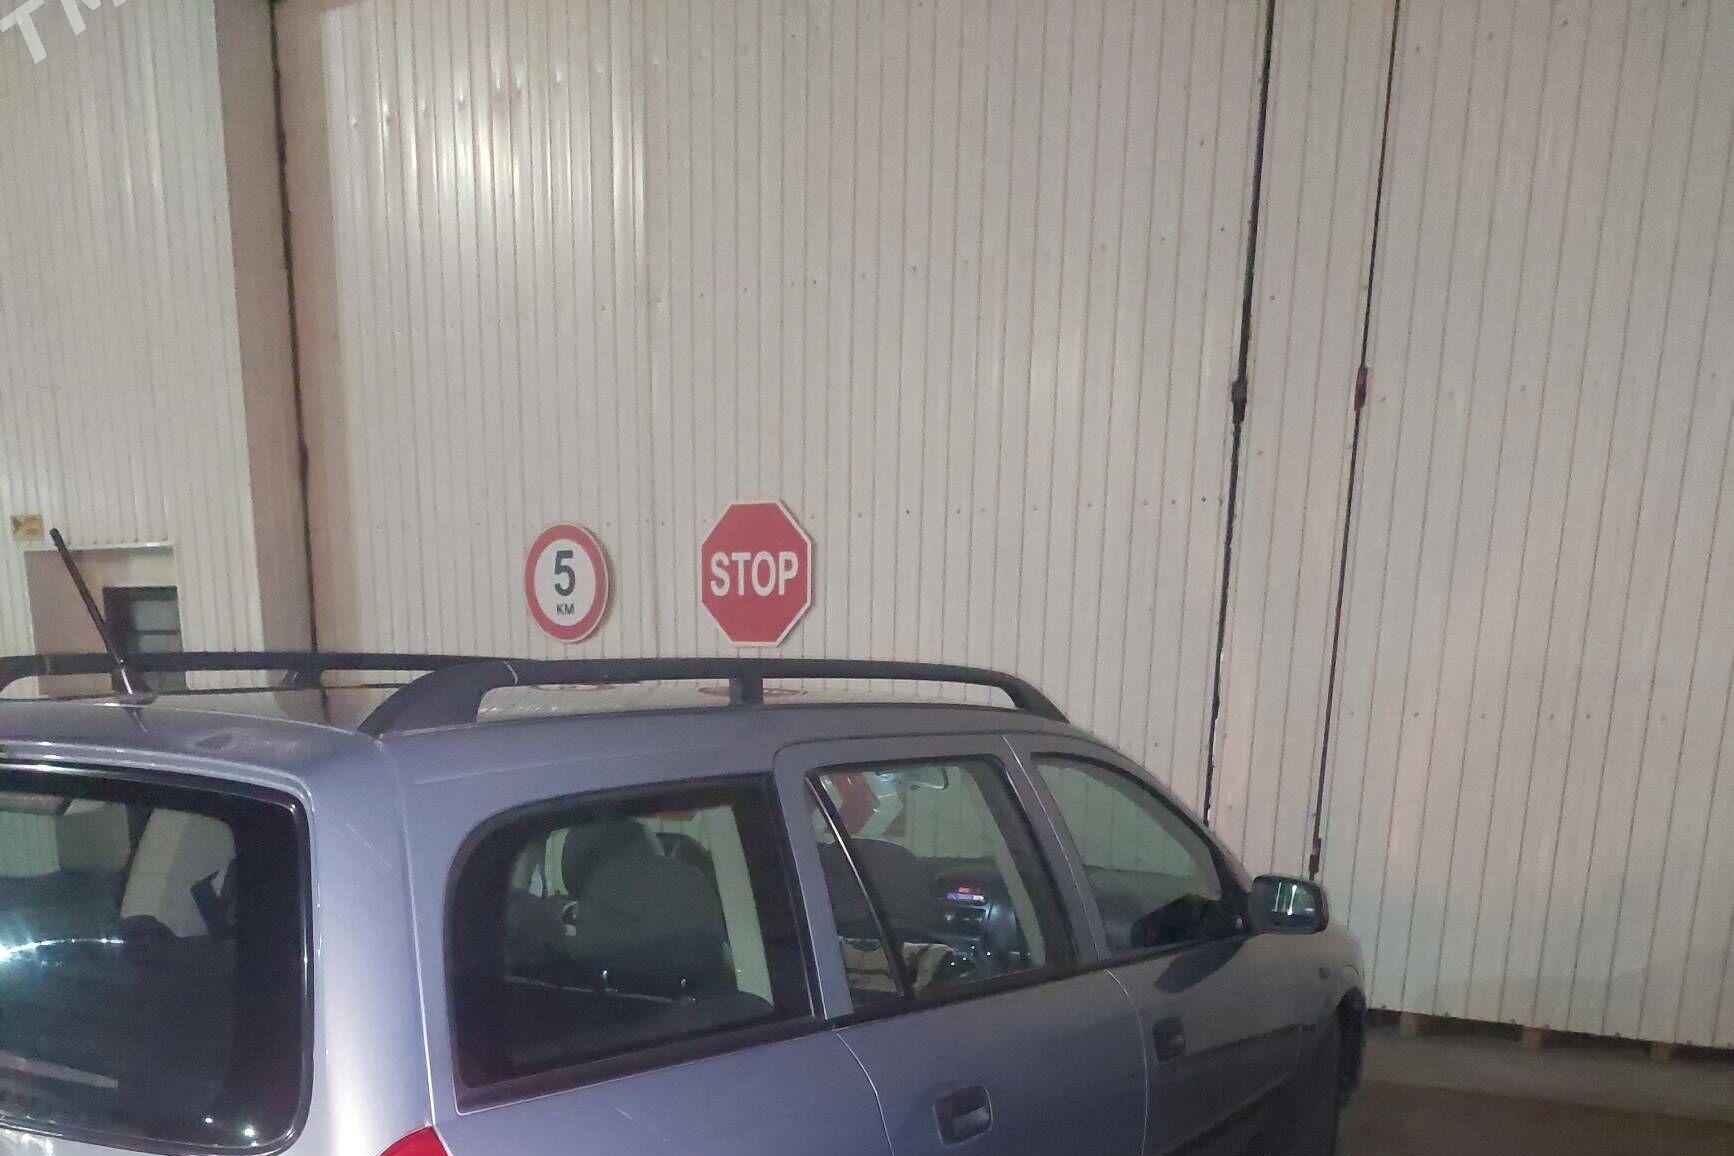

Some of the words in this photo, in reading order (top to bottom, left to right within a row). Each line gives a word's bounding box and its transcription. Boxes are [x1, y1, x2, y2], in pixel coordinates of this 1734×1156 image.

[554, 549, 576, 596] 5
[710, 551, 799, 597] STOP
[556, 603, 575, 616] KM
